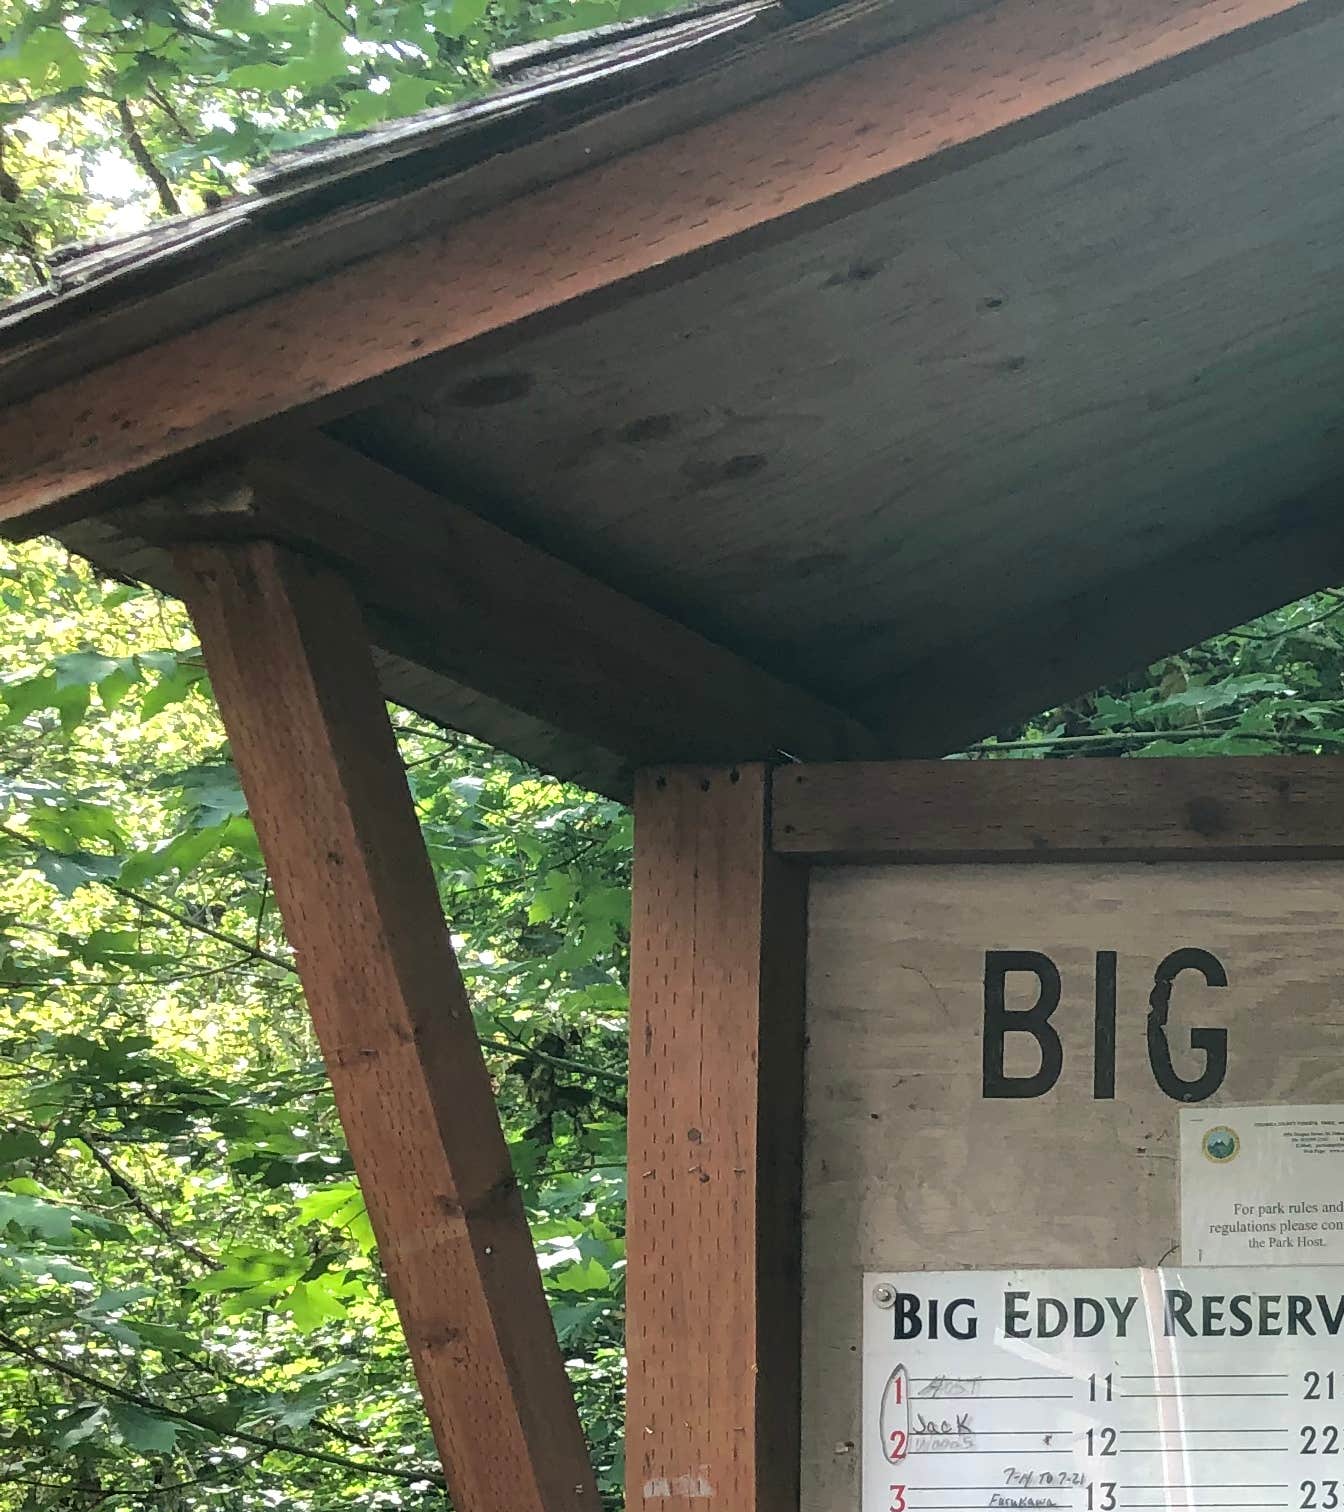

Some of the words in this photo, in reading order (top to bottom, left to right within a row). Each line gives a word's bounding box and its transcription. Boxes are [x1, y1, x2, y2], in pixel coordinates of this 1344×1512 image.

[983, 948, 1228, 1101] BIG
[1234, 1204, 1254, 1215] For
[1258, 1202, 1284, 1217] park
[1289, 1202, 1318, 1214] rules
[1322, 1201, 1343, 1213] and
[1209, 1221, 1276, 1235] regulations
[1280, 1220, 1317, 1234] please
[1249, 1238, 1265, 1248] the
[1269, 1237, 1293, 1248] Park
[1297, 1236, 1326, 1247] Host.
[893, 1292, 977, 1340] BIG
[1004, 1291, 1138, 1339] EDDY
[893, 1378, 902, 1404] 1
[1089, 1374, 1113, 1402] 11
[1304, 1371, 1336, 1400] 21
[890, 1431, 906, 1458] 2
[1086, 1428, 1117, 1456] 12
[1301, 1425, 1339, 1455] 22
[890, 1485, 905, 1512] 3
[1087, 1483, 1117, 1511] 13
[1301, 1480, 1339, 1509] 23
